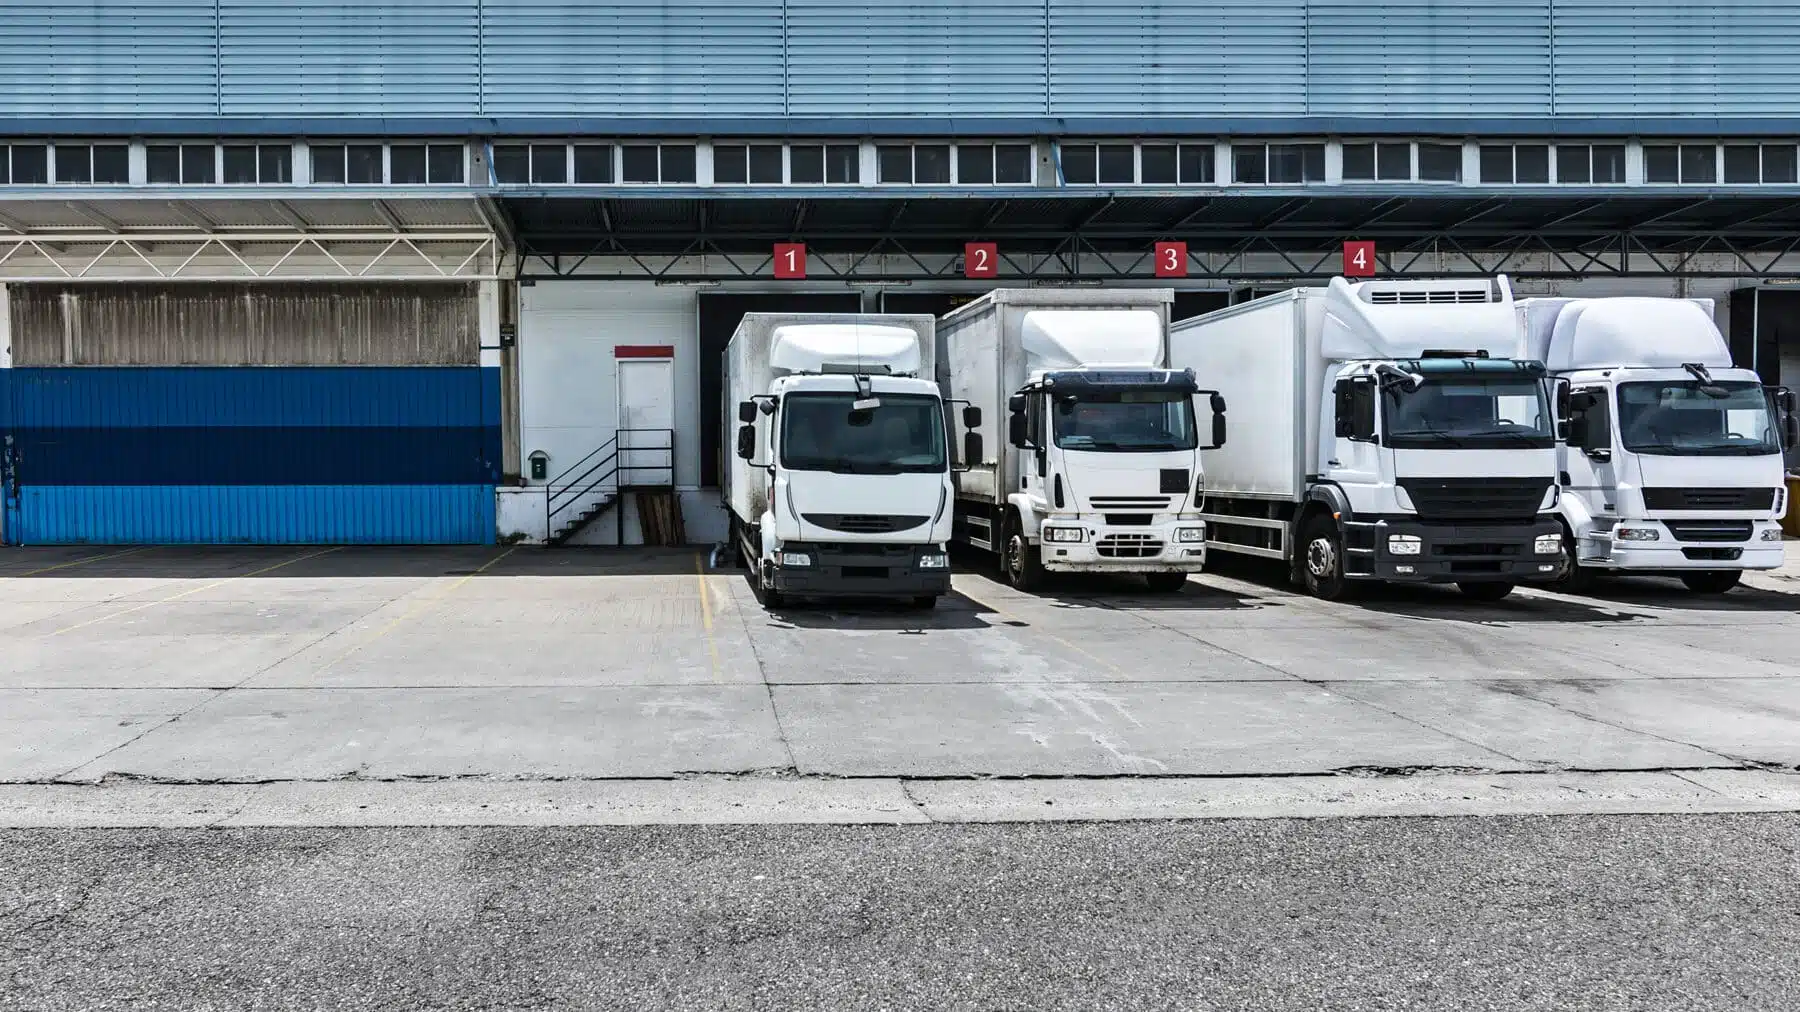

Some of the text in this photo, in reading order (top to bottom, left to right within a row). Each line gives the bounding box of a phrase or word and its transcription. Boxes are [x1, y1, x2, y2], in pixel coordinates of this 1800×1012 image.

[785, 249, 795, 272] 1
[974, 249, 988, 271] 2
[1164, 249, 1178, 271] 3
[1352, 247, 1367, 270] 4
